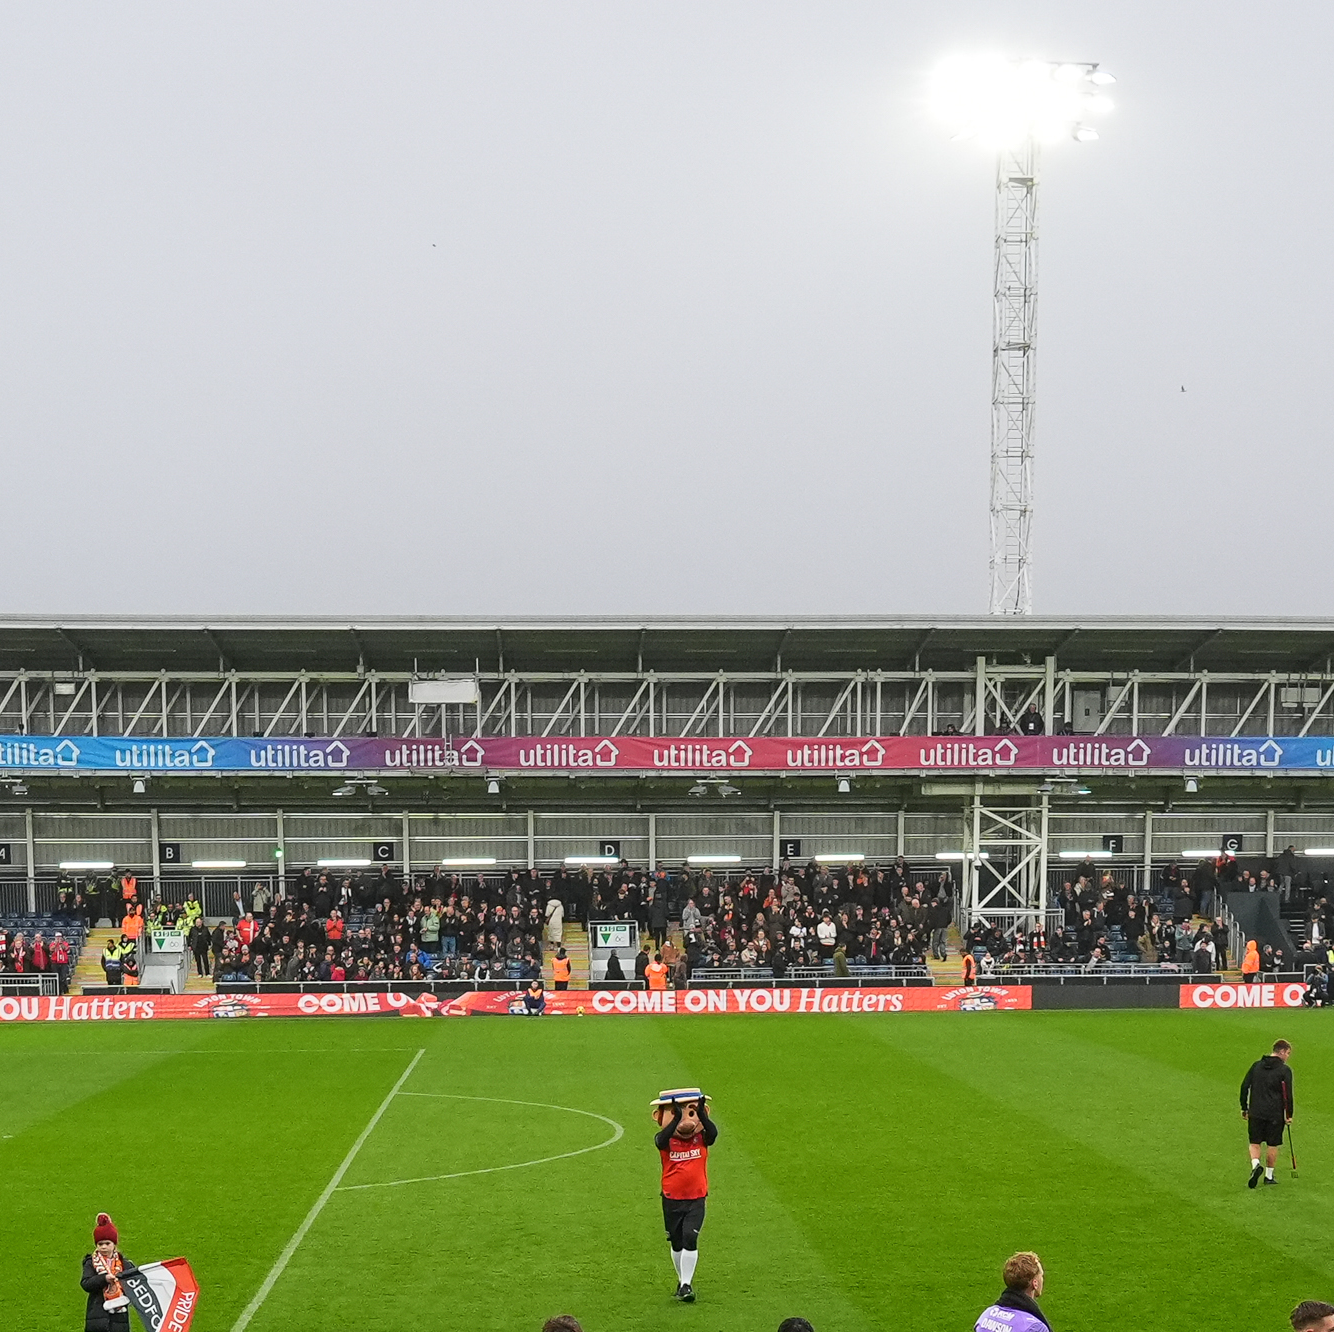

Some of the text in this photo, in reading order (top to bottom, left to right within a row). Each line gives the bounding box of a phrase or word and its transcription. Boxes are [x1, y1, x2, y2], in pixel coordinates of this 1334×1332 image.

[115, 744, 190, 766] utilita
[250, 744, 325, 767] utilita
[384, 744, 459, 767] utilita
[519, 744, 594, 766] utilita
[653, 744, 727, 767] utilita
[786, 744, 861, 767] utilita
[919, 744, 993, 766] utilita
[1052, 743, 1126, 766] utilita
[1184, 743, 1258, 766] utilita
[166, 847, 174, 859] B
[378, 846, 389, 858] C
[605, 845, 615, 856] D
[787, 844, 795, 855] E
[1109, 840, 1117, 851] F
[1227, 839, 1238, 850] G
[193, 994, 227, 1008] LUTON
[298, 993, 380, 1014] COME
[592, 986, 903, 1012] COME ON YOU Hatters
[1192, 985, 1275, 1007] COME
[46, 994, 155, 1021] Hatters
[126, 1278, 163, 1331] BEDFO
